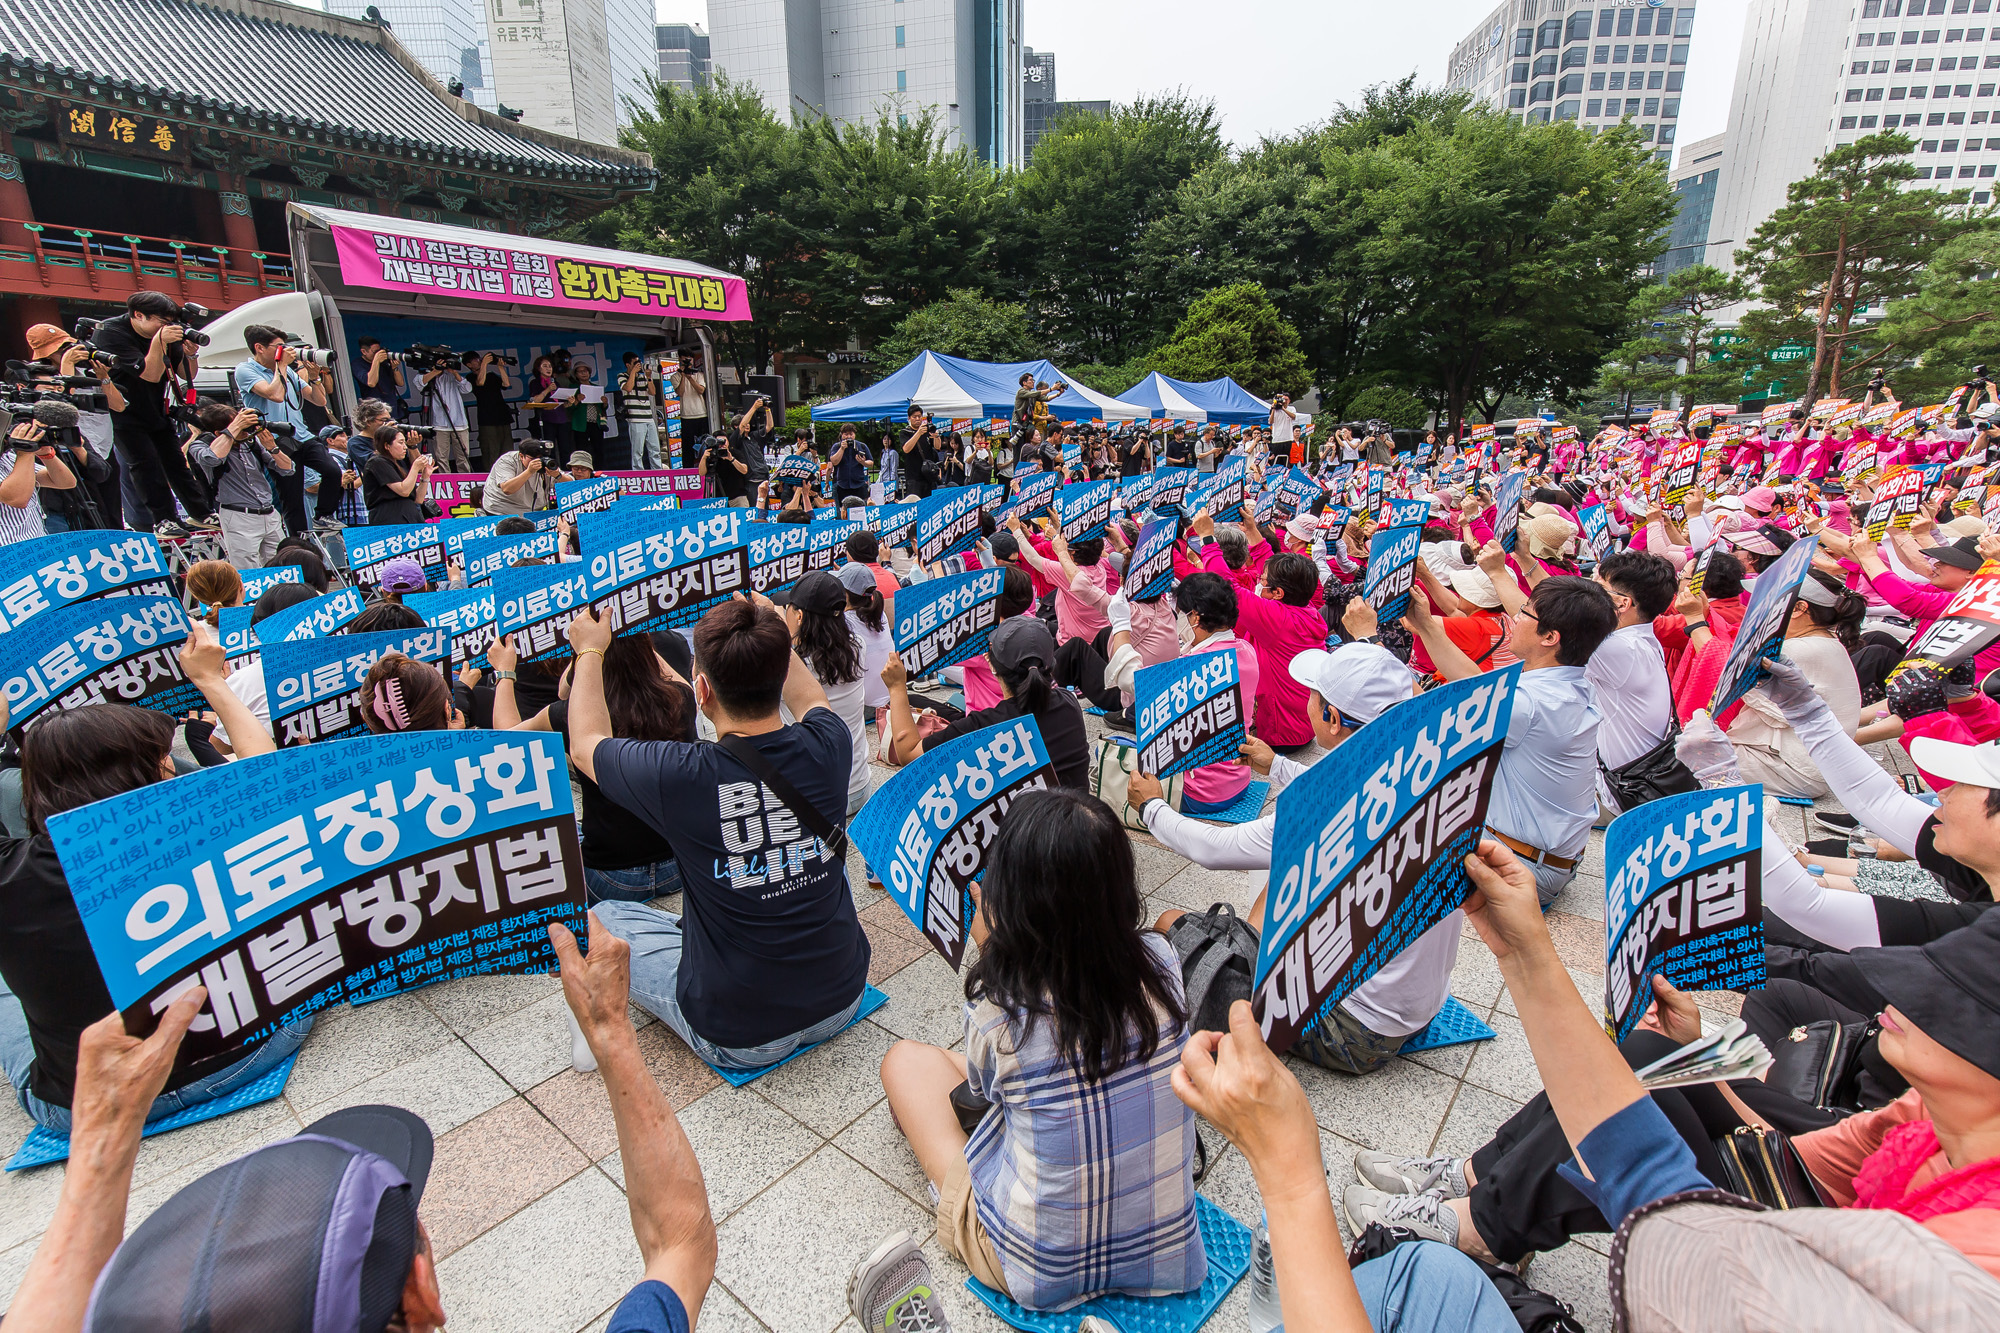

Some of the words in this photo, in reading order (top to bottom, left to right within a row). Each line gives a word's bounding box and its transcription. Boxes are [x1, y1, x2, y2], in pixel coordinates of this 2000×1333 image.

[373, 233, 422, 260] 의사
[424, 240, 509, 270] 집단휴진
[510, 251, 551, 275] 철회
[380, 257, 507, 294] 재발방지법
[509, 273, 555, 299] 제정
[555, 258, 727, 313] 환자촉구대회
[560, 478, 617, 510] 의료정상화
[674, 474, 702, 491] 제정
[920, 485, 982, 541] 의료정상화
[1064, 482, 1111, 521] 의료정상화
[352, 525, 440, 566] 의료정상화
[590, 511, 741, 592] 의료정상화
[750, 526, 809, 564] 정상화
[919, 507, 980, 564] 재발방지법
[1063, 501, 1110, 541] 재발방지법
[595, 551, 743, 633] 재발방지법
[899, 569, 1002, 646] 의료정상화
[1, 600, 191, 715] 의료정상화
[902, 599, 998, 677] 재발방지법
[1140, 651, 1234, 742] 의료정상화
[1141, 689, 1237, 776] 재발방지법
[72, 839, 149, 894] 촉구대회
[169, 807, 205, 841] 의사
[209, 774, 278, 819] 집단휴진
[283, 757, 318, 783] 철회
[319, 748, 337, 768] 및
[341, 737, 373, 761] 재발
[77, 807, 118, 840] 의사
[80, 841, 192, 918] 환자촉구대회
[210, 813, 245, 842] 의사
[249, 780, 318, 822] 집단휴진
[320, 764, 351, 789] 철회
[356, 758, 373, 775] 및
[376, 749, 408, 772] 재발
[409, 737, 454, 761] 방지법
[124, 807, 162, 840] 의사
[168, 769, 239, 818] 집단휴진
[243, 753, 278, 782] 철회
[890, 722, 1039, 912] 의료정상화
[1267, 672, 1509, 957] 의료정상화
[125, 739, 556, 977] 의료정상화
[150, 827, 568, 1039] 재발방지법
[1261, 757, 1488, 1043] 재발방지법
[280, 981, 344, 1029] 집단휴진
[345, 965, 377, 991] 철회
[378, 956, 395, 974] 및
[397, 943, 426, 967] 재발
[428, 928, 470, 956] 방지법
[471, 922, 499, 942] 제정
[501, 902, 576, 935] 환자촉구대회
[401, 957, 443, 985] 방지법
[446, 949, 474, 968] 제정
[474, 924, 551, 962] 환자촉구대회
[452, 949, 529, 979] 환자촉구대회
[1610, 861, 1747, 1023] 발방지법
[1665, 945, 1727, 975] 환자촉구대회
[1736, 940, 1759, 955] 의사
[1666, 941, 1687, 960] 제정
[1687, 924, 1750, 954] 환자촉구대회
[1717, 958, 1740, 975] 의사
